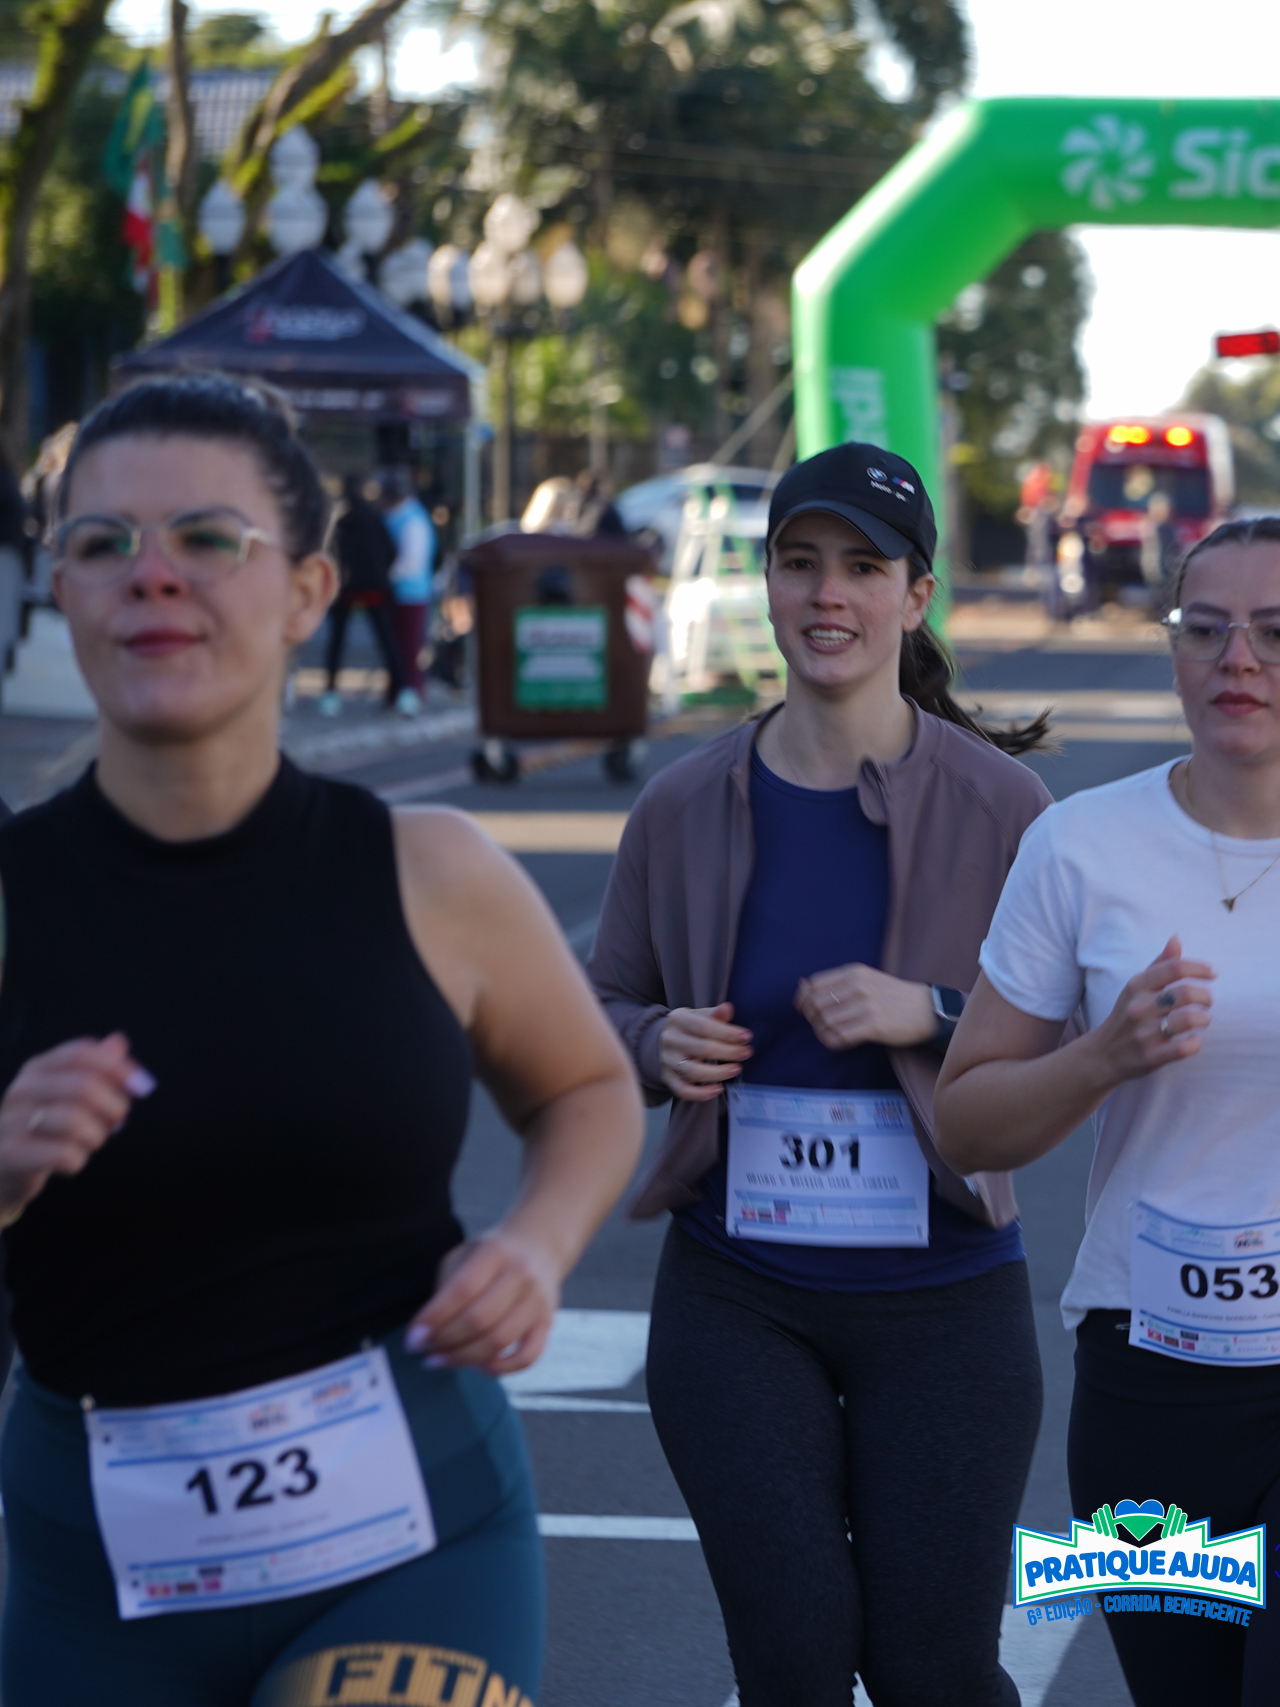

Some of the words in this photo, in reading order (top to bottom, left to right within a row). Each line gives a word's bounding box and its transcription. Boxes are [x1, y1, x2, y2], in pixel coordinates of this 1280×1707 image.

[778, 1130, 862, 1175] 301
[1180, 1263, 1280, 1301] 053
[185, 1447, 319, 1516] 123
[325, 1650, 535, 1707] FITN
